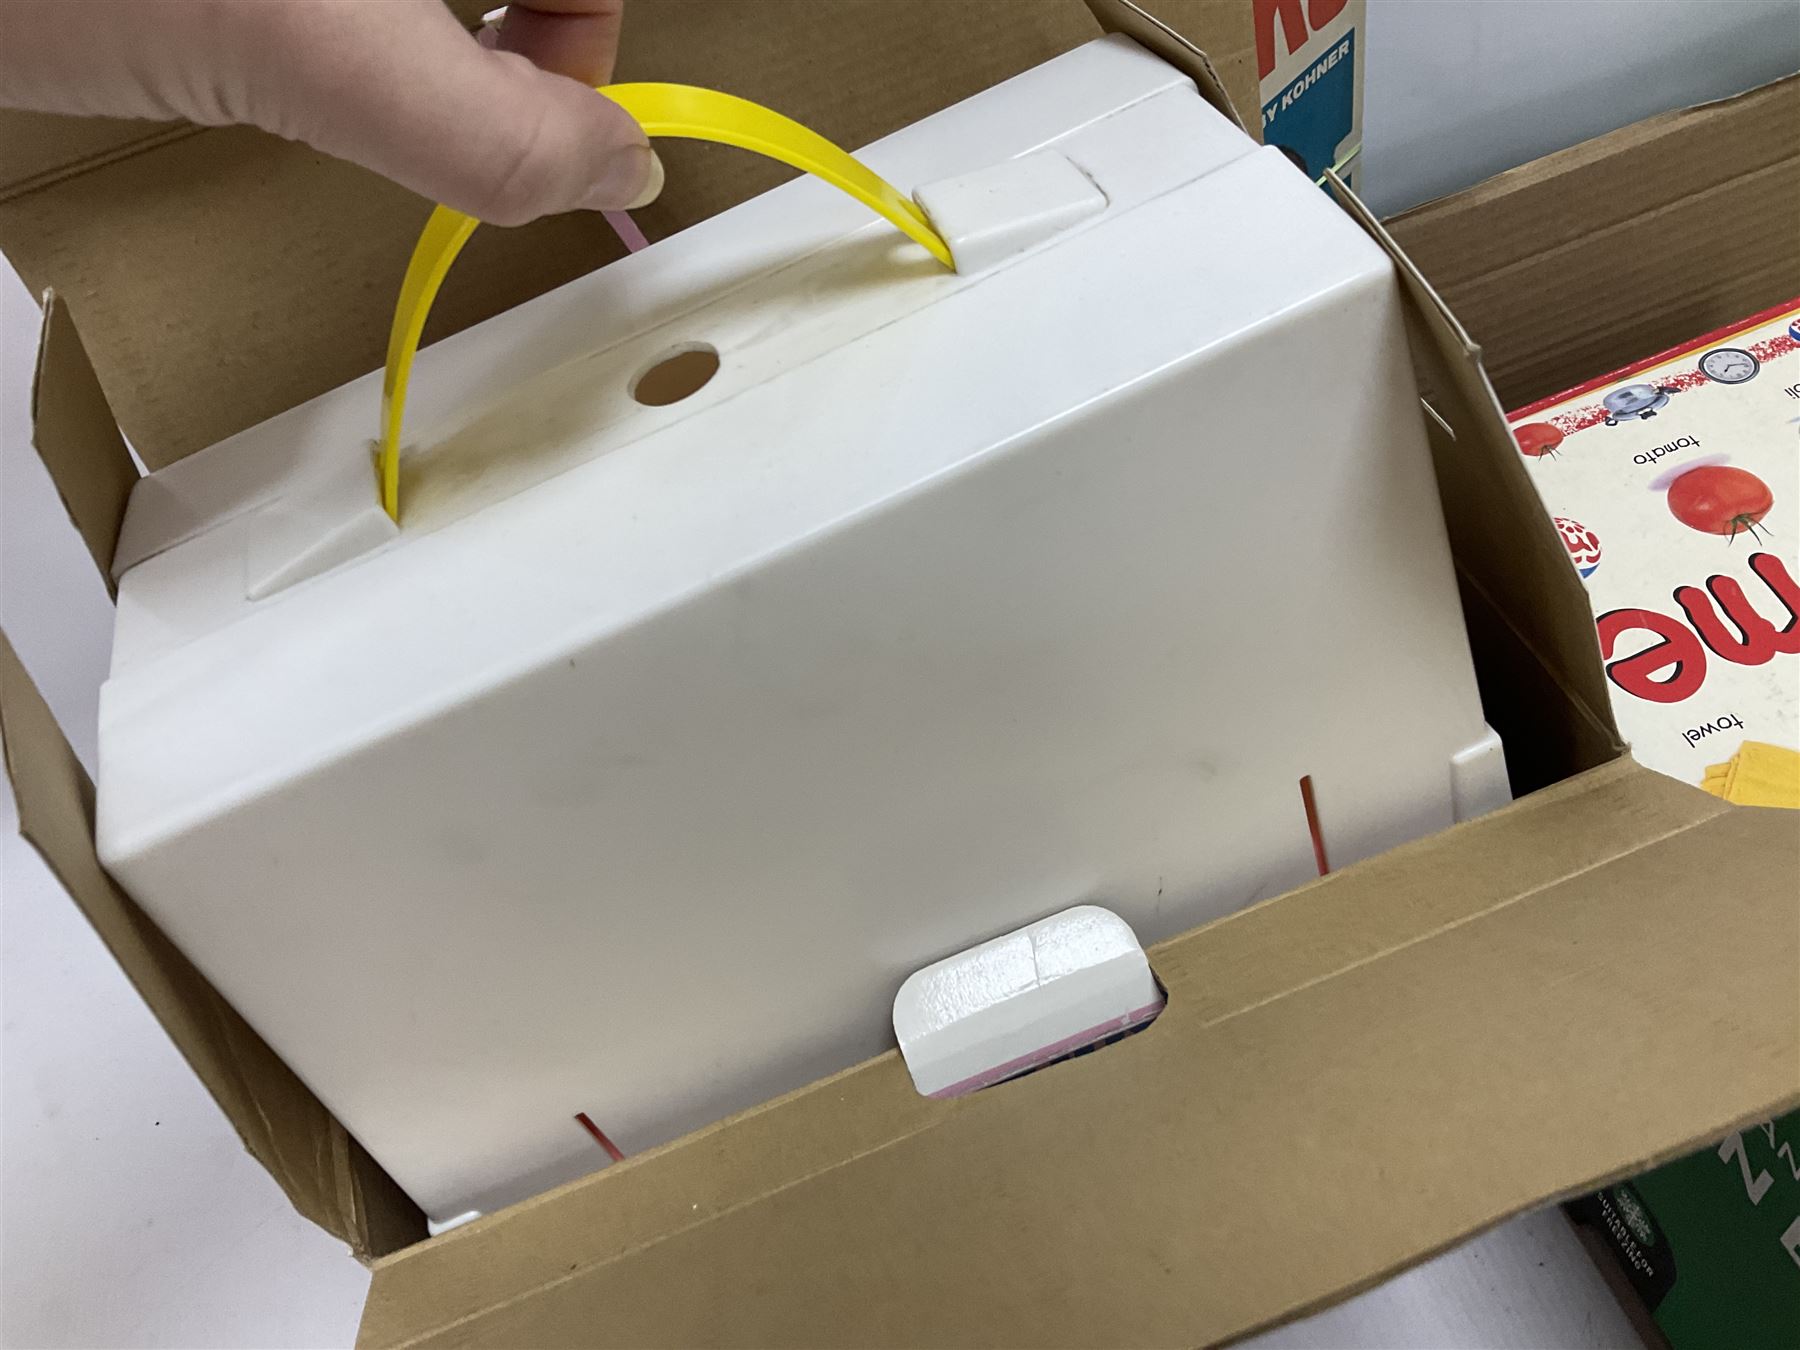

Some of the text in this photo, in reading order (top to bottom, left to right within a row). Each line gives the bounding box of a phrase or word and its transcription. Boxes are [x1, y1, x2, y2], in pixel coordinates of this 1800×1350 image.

[1281, 39, 1350, 111] KOHNER
[1633, 435, 1701, 465] tomato
[1682, 713, 1744, 748] towel
[1598, 1191, 1654, 1277] SUITABLE FOR
[1601, 1209, 1641, 1270] FREEZING
